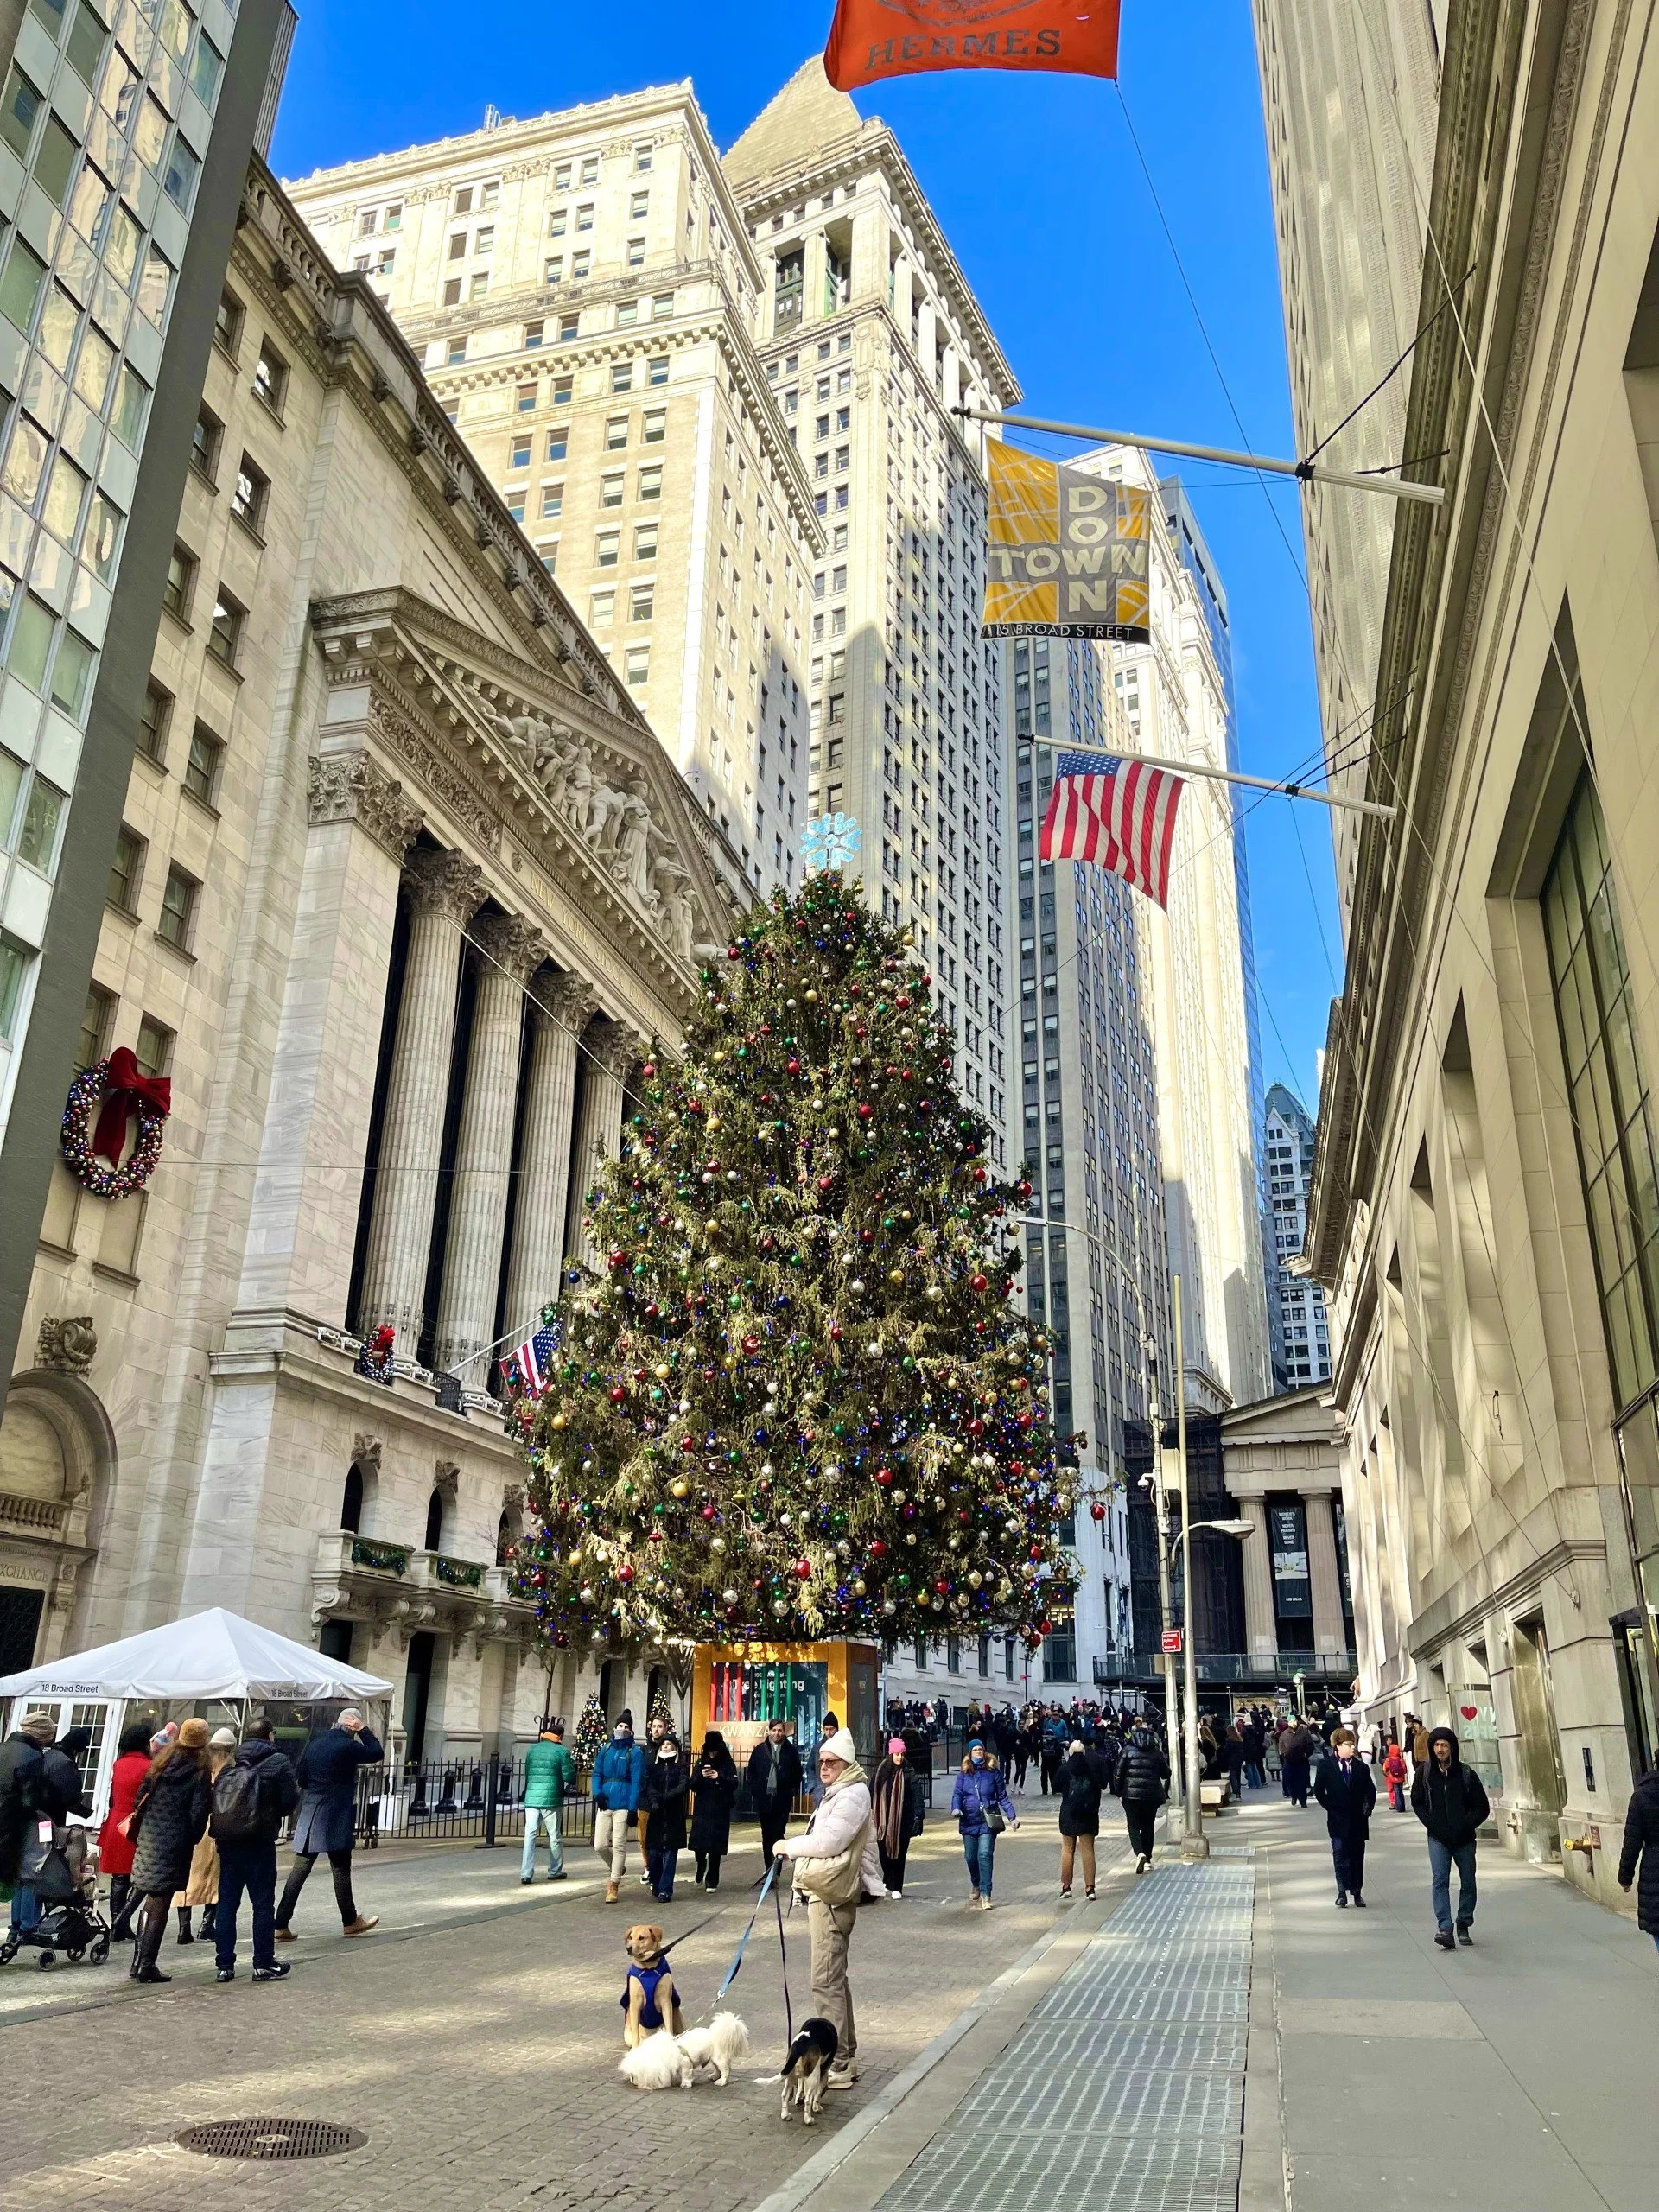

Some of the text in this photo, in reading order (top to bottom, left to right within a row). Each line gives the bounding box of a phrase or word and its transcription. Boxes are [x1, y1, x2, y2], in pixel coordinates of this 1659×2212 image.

[988, 544, 1146, 578] TOWN
[995, 624, 1133, 639] 15 BROAD STREET
[530, 869, 555, 910] NEW
[560, 904, 588, 950] YORK
[594, 945, 624, 988] STOCK
[0, 1562, 48, 1582] XCHANGE
[51, 1684, 74, 1693] Broad
[75, 1684, 99, 1693] Street
[277, 1689, 293, 1698] Broad
[719, 1724, 770, 1738] KWANZA
